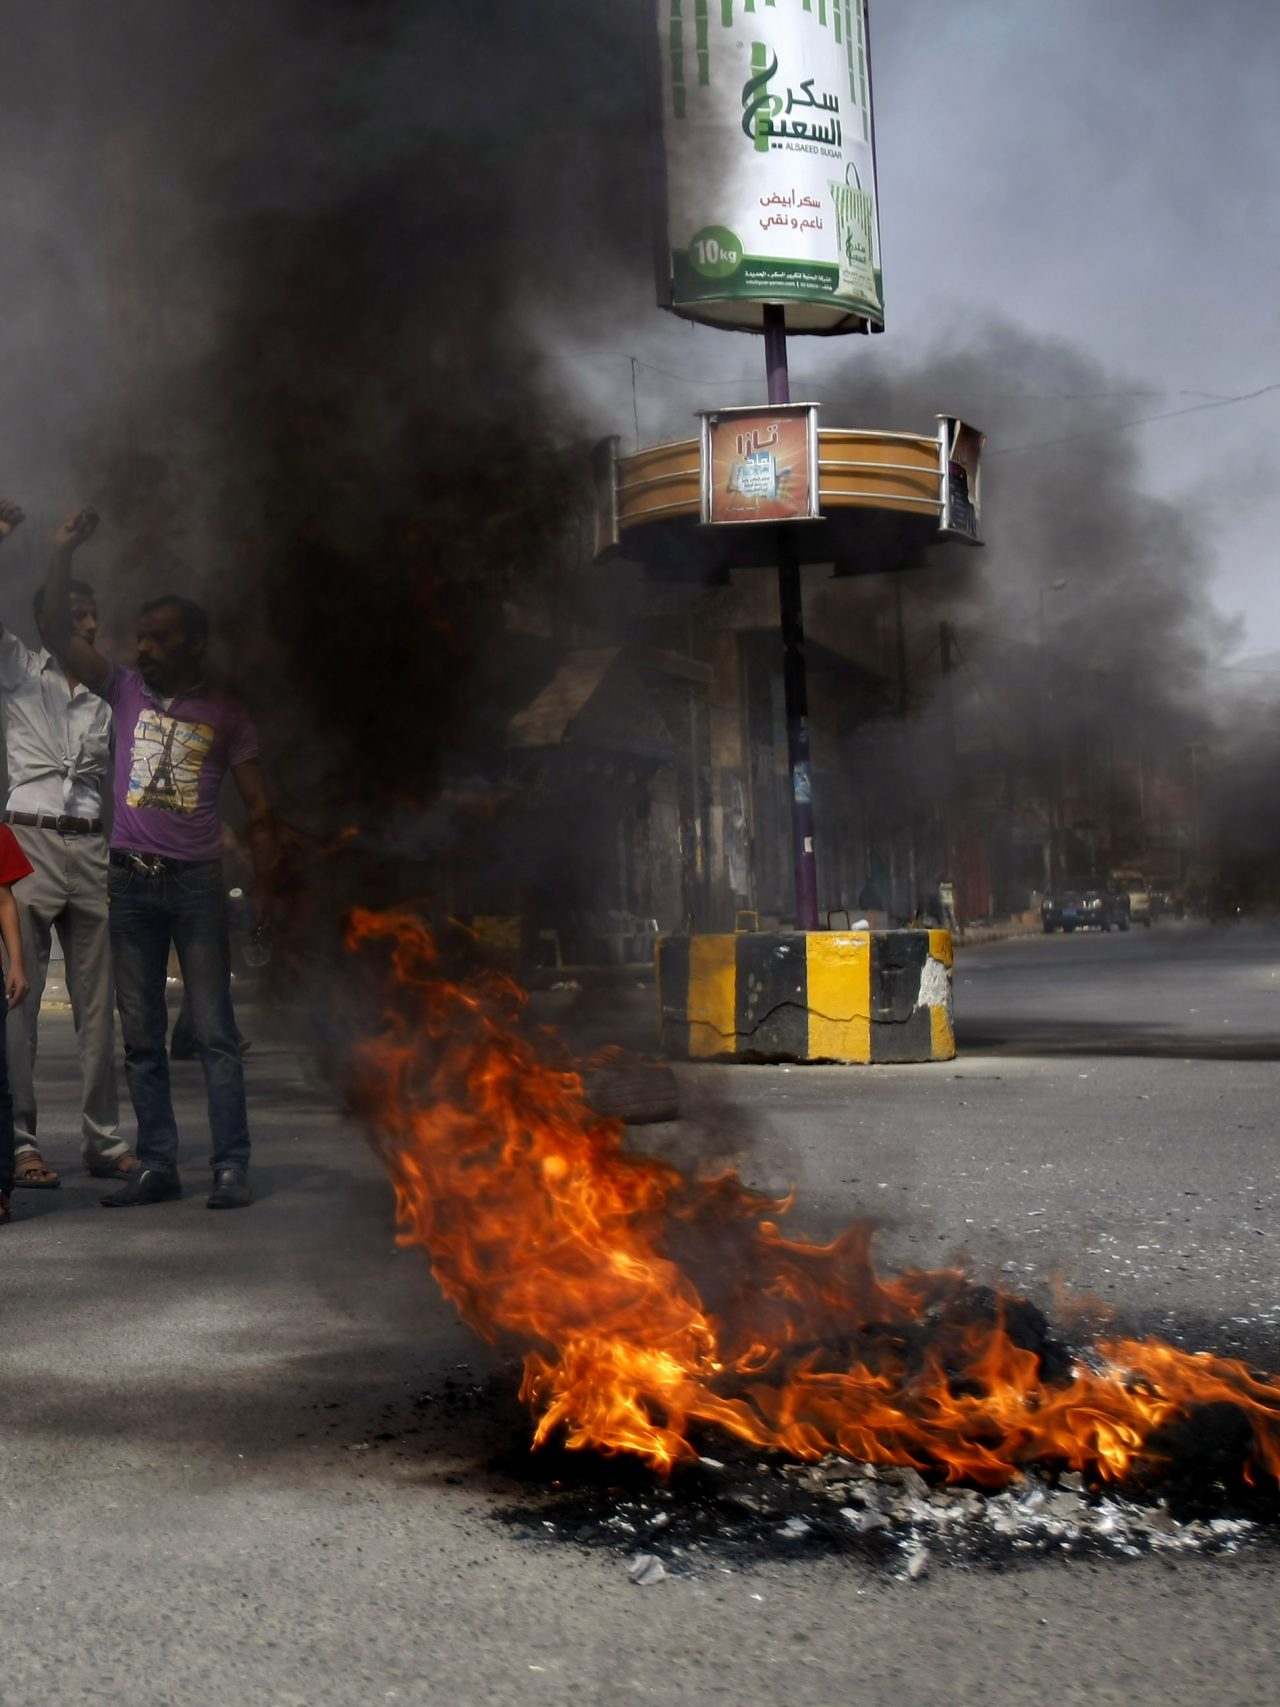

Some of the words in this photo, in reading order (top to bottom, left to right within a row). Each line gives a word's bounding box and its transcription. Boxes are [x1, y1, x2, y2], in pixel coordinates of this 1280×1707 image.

[785, 78, 839, 115] سكر
[757, 117, 842, 149] السعيد
[785, 142, 819, 155] ALSAEED
[820, 147, 843, 160] SUGAR
[796, 196, 821, 208] سكر
[759, 213, 789, 231] نقي
[800, 215, 823, 232] ناعم
[736, 424, 779, 460] تازا
